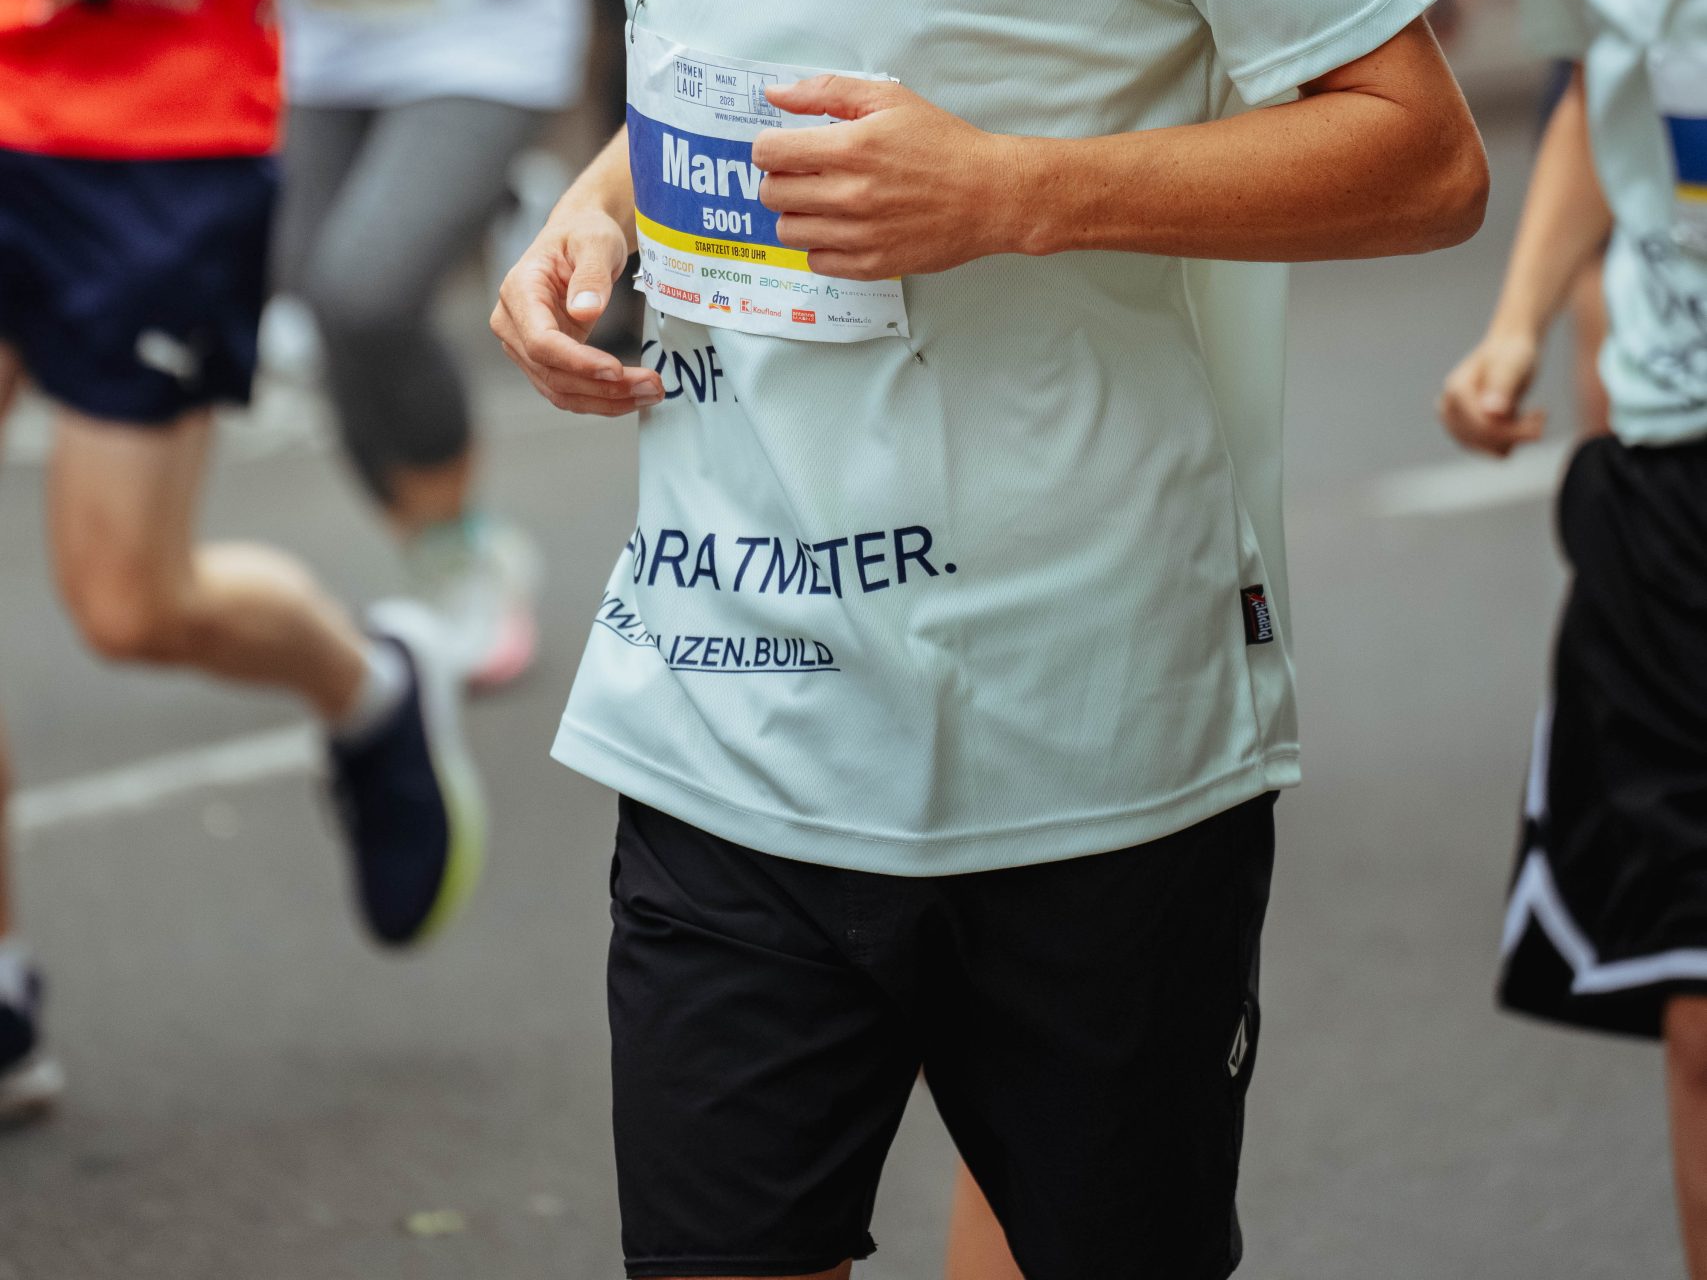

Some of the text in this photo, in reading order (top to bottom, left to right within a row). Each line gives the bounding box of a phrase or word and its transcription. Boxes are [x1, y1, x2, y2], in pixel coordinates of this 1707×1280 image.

[676, 61, 703, 79] FIRMEN
[676, 75, 703, 99] LAUF
[715, 73, 737, 87] MAINZ
[662, 132, 769, 201] Marv
[702, 207, 752, 235] 5001
[695, 240, 767, 260] STARTZEIT 18:30 UHR
[660, 285, 700, 303] BAUHAUS
[759, 277, 819, 295] BIONTECH
[712, 291, 730, 306] dm
[753, 307, 782, 317] Kaufland
[827, 315, 872, 324] Merkurist.de
